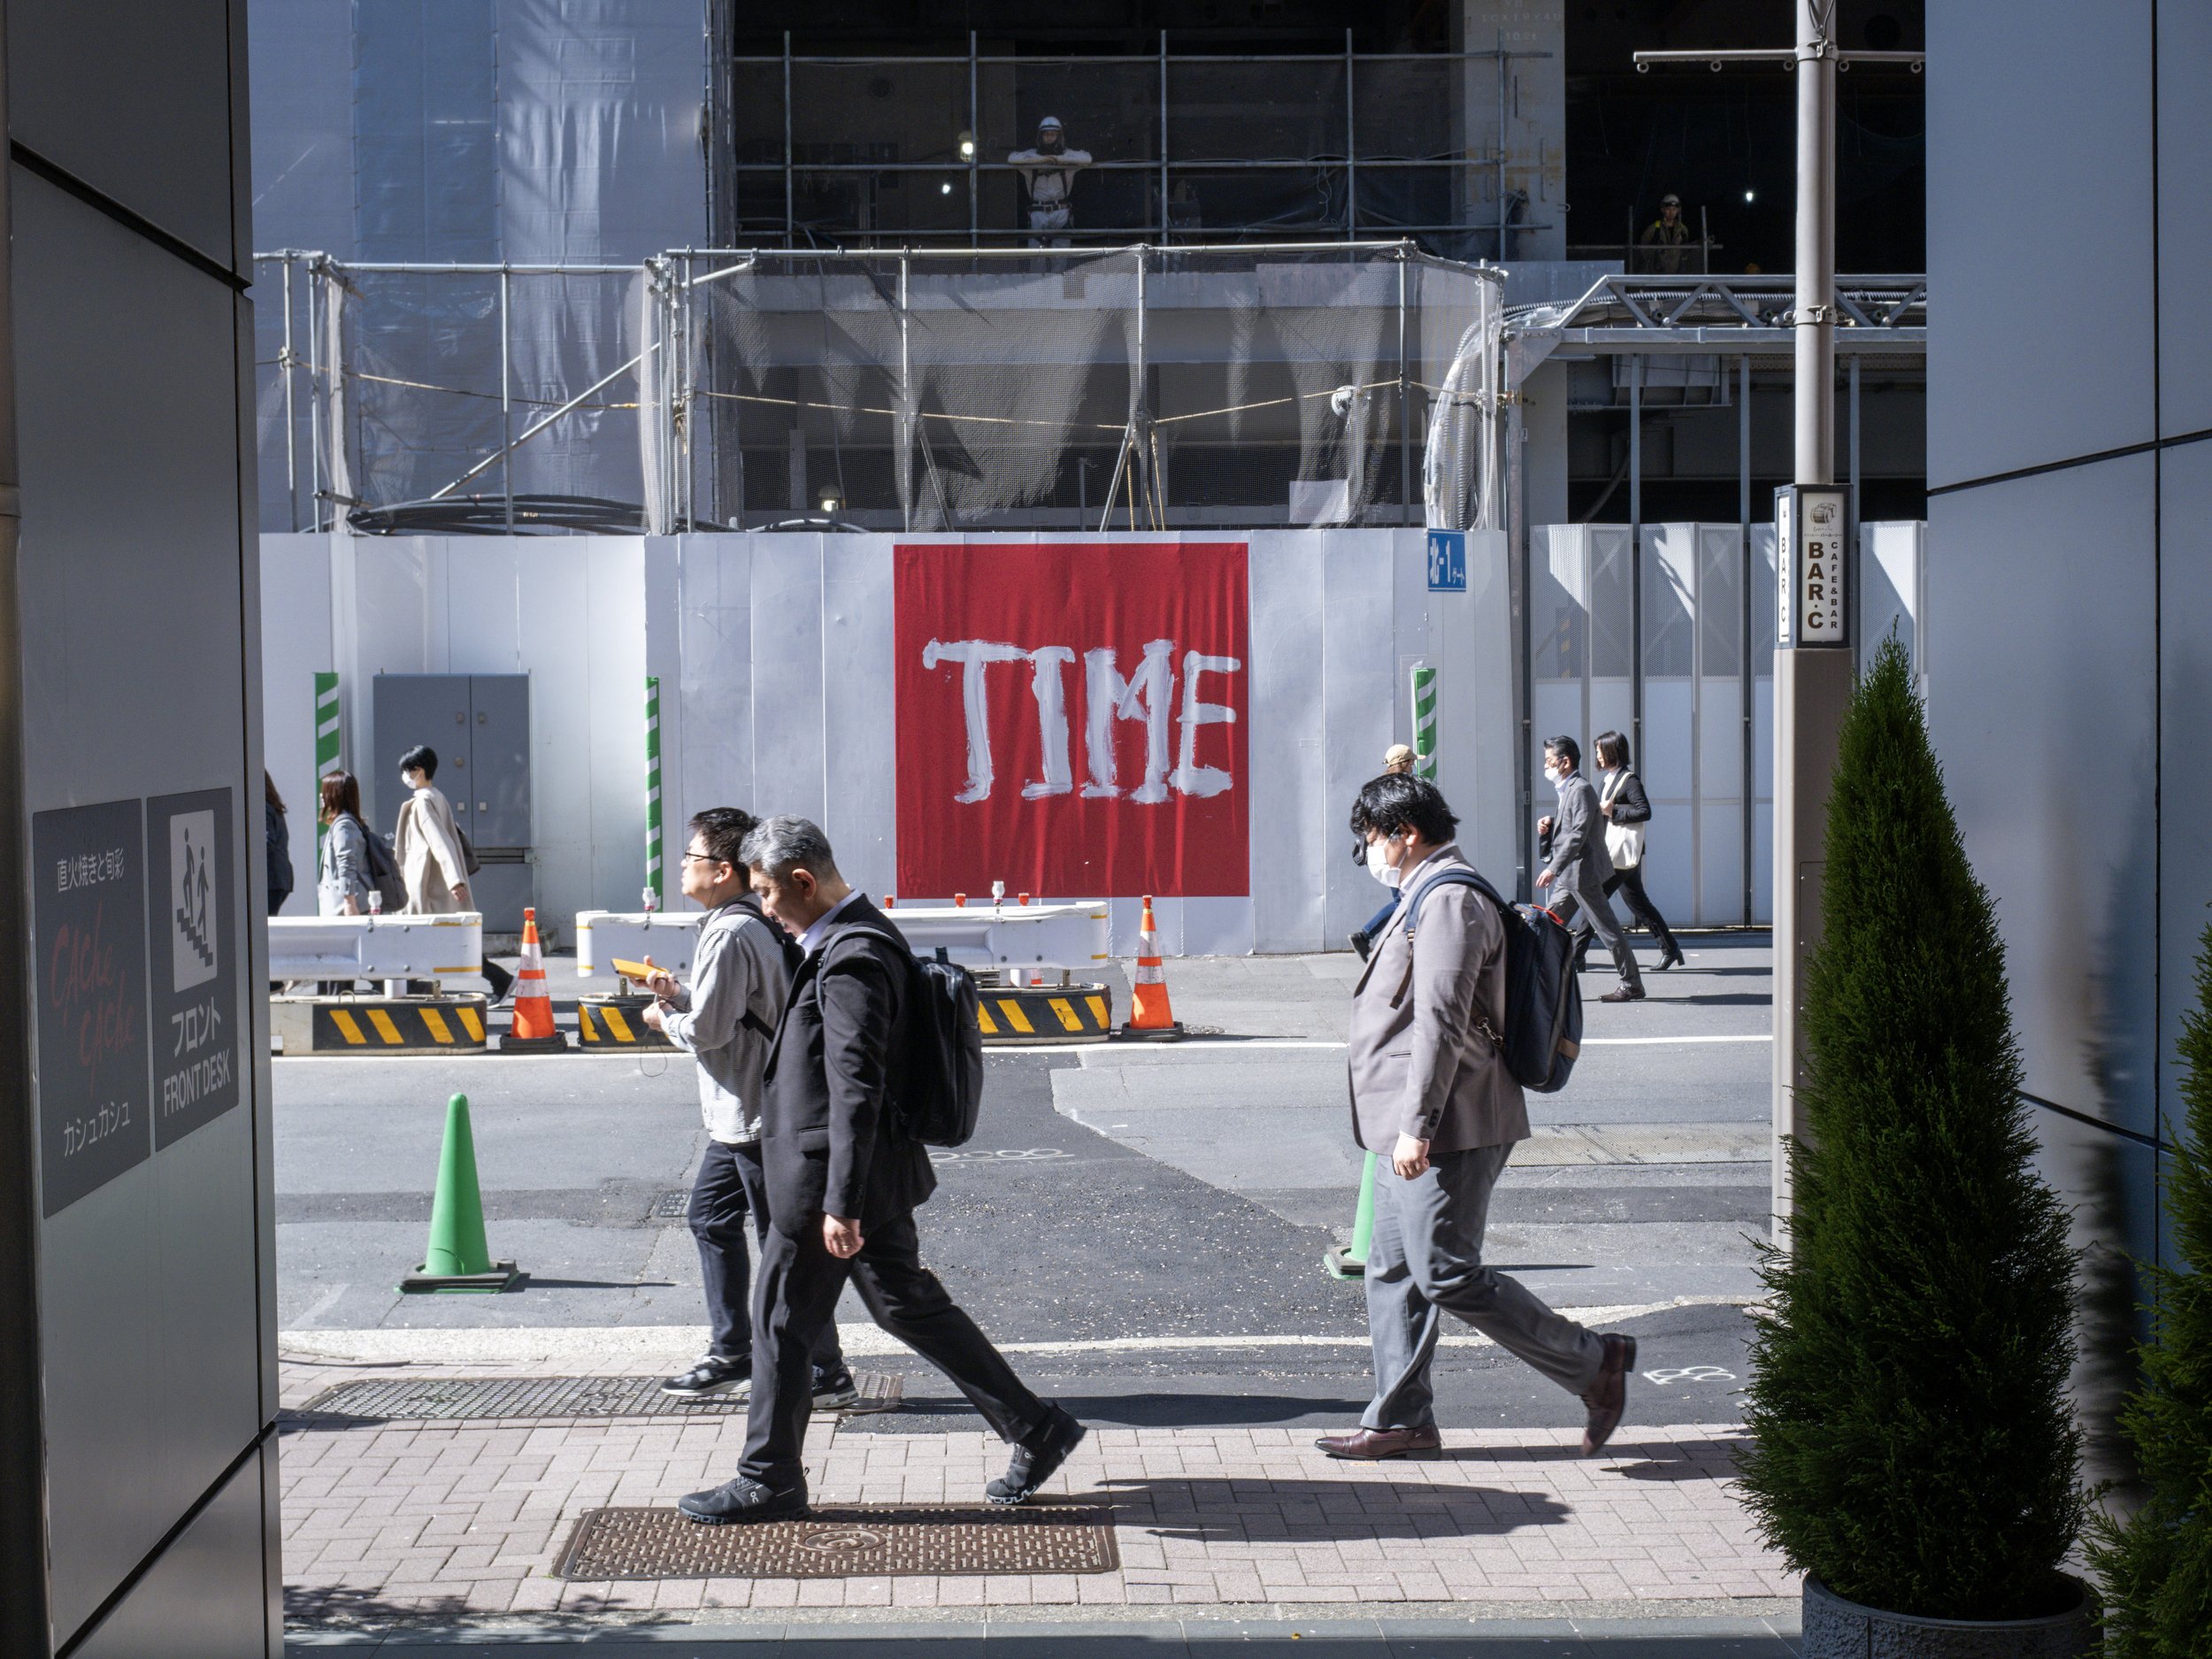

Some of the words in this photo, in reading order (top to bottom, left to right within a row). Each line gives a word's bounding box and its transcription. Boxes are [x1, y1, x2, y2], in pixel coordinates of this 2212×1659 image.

[923, 638, 1240, 803] TIME
[57, 847, 125, 893] 直火焼きと旬彩
[172, 996, 221, 1057] フロント
[164, 1063, 201, 1117] FRONT
[204, 1048, 231, 1096] DESK
[64, 1101, 130, 1157] カシュカシュ
